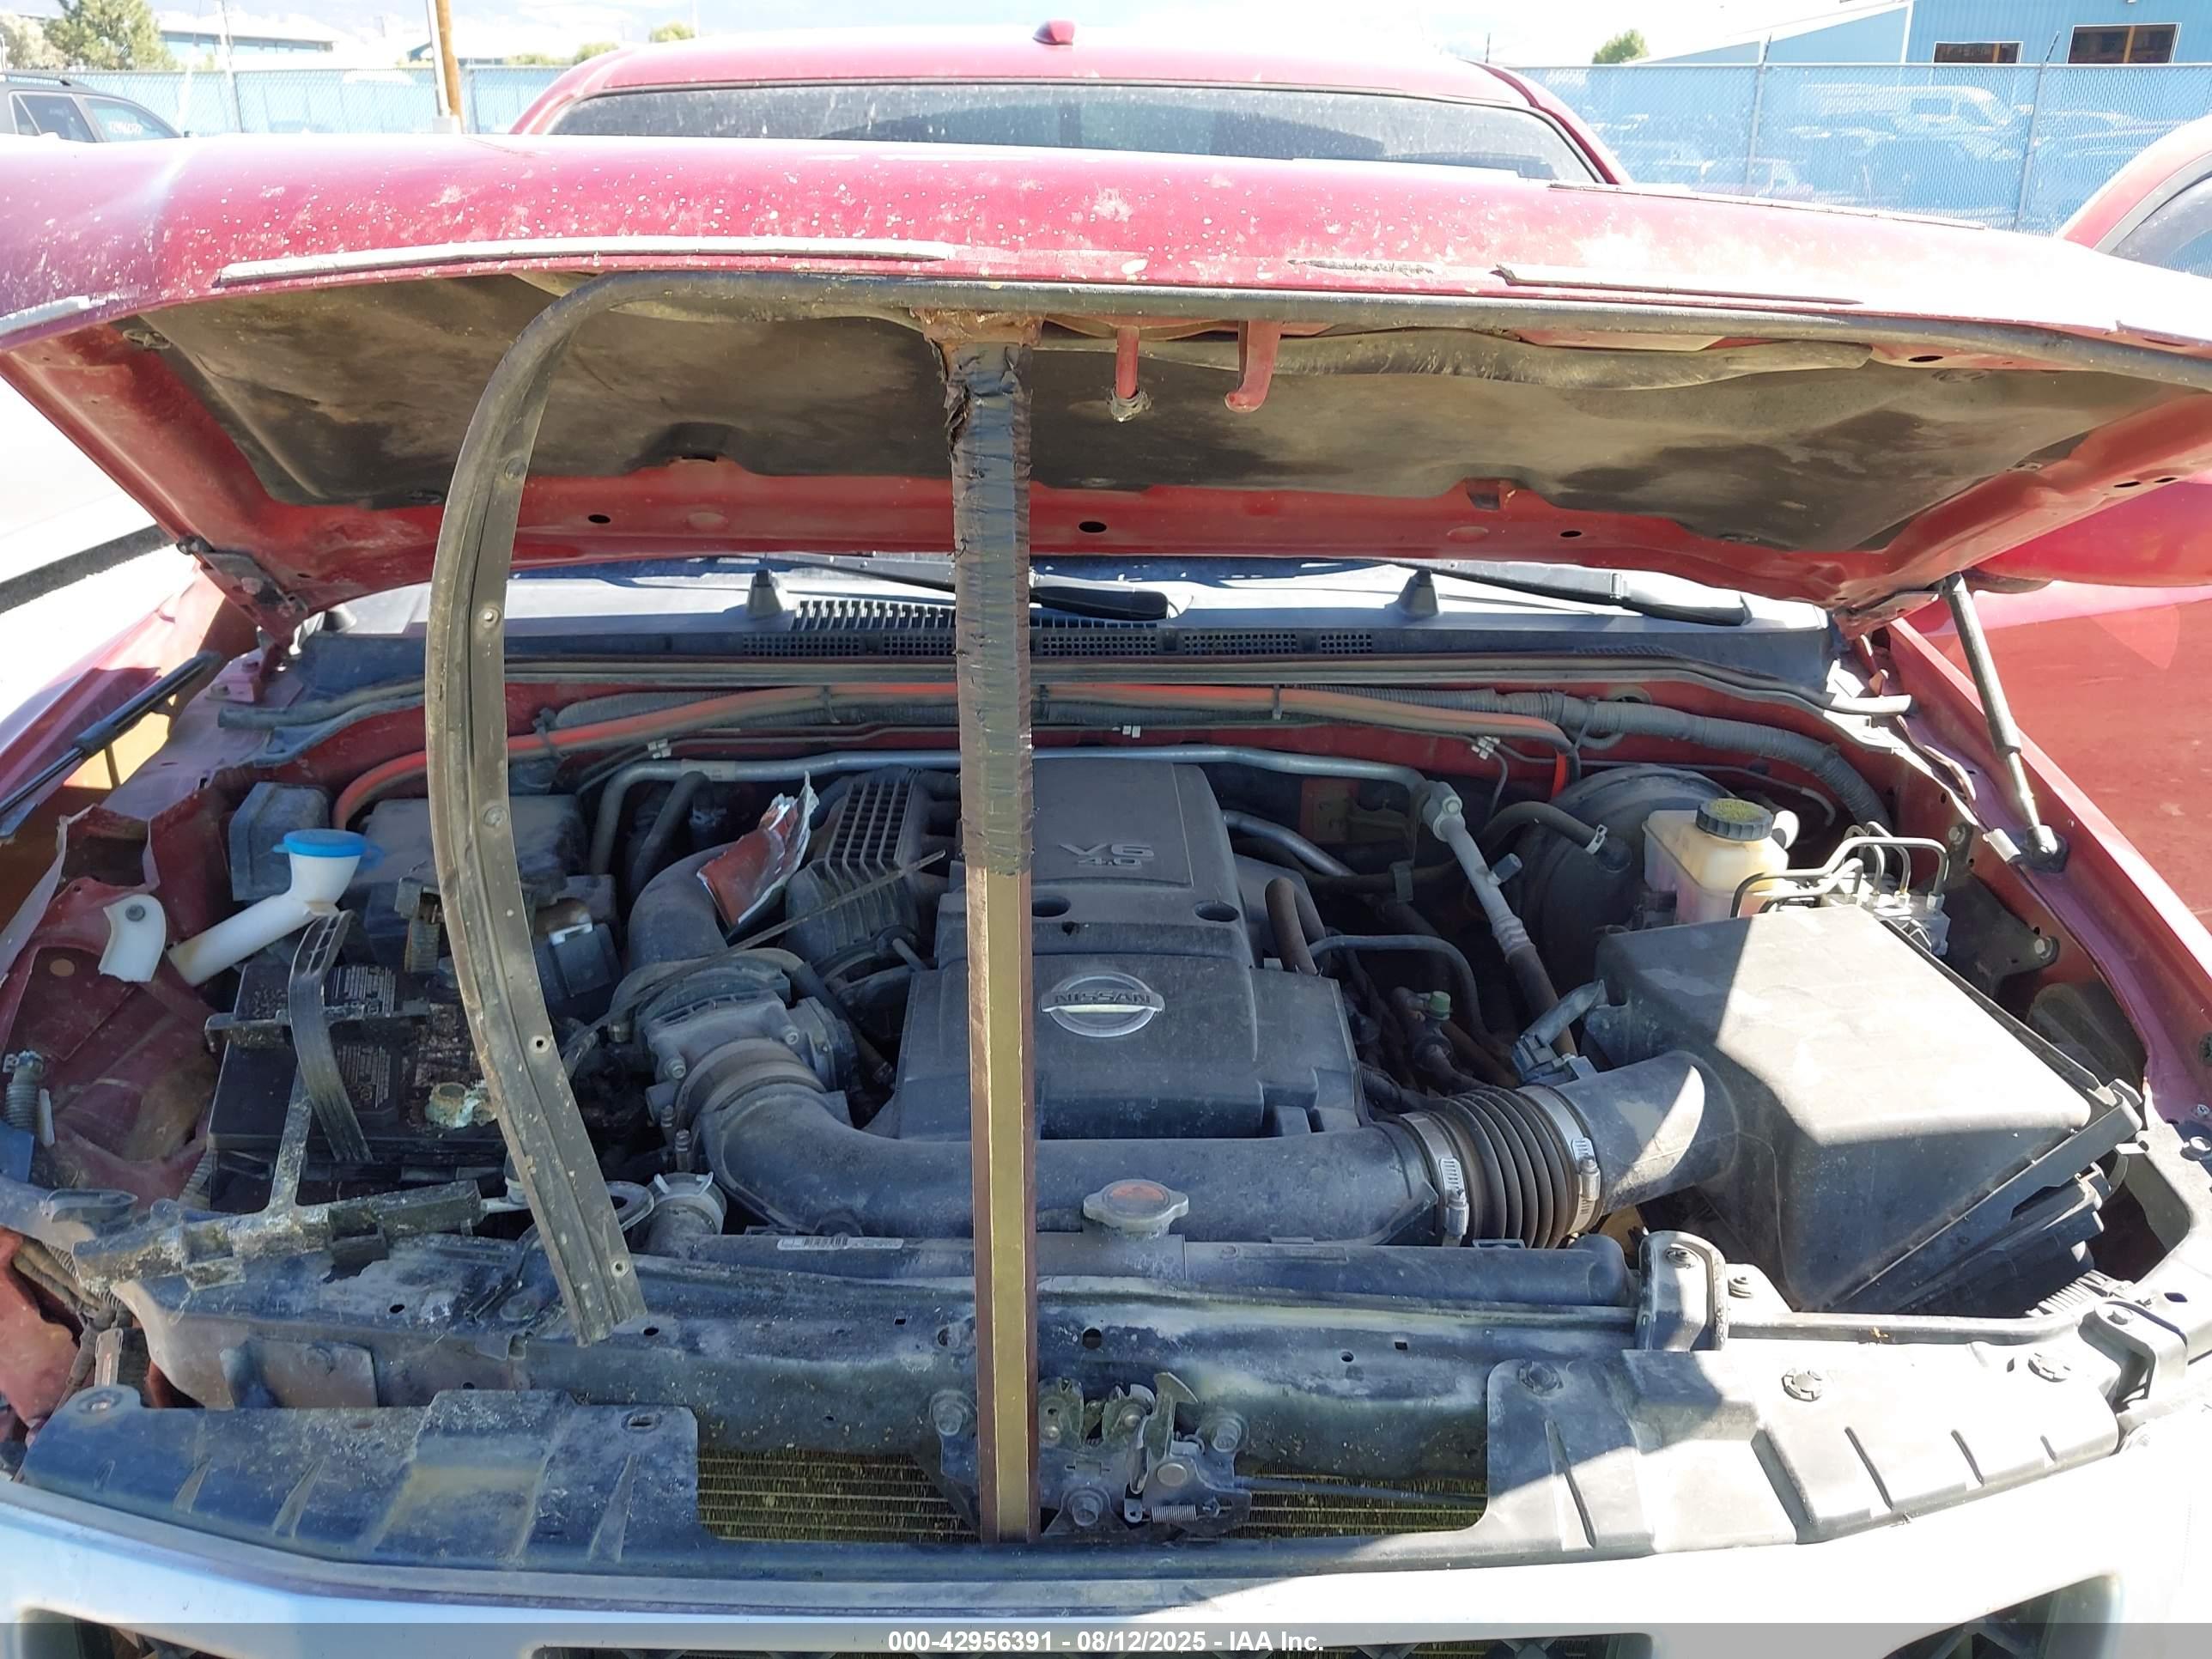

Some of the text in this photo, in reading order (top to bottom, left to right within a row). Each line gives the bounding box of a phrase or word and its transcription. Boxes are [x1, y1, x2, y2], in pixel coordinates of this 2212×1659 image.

[1058, 843, 1154, 858] V6
[1078, 858, 1142, 869] 4.0
[1054, 990, 1151, 1004] NISSAN
